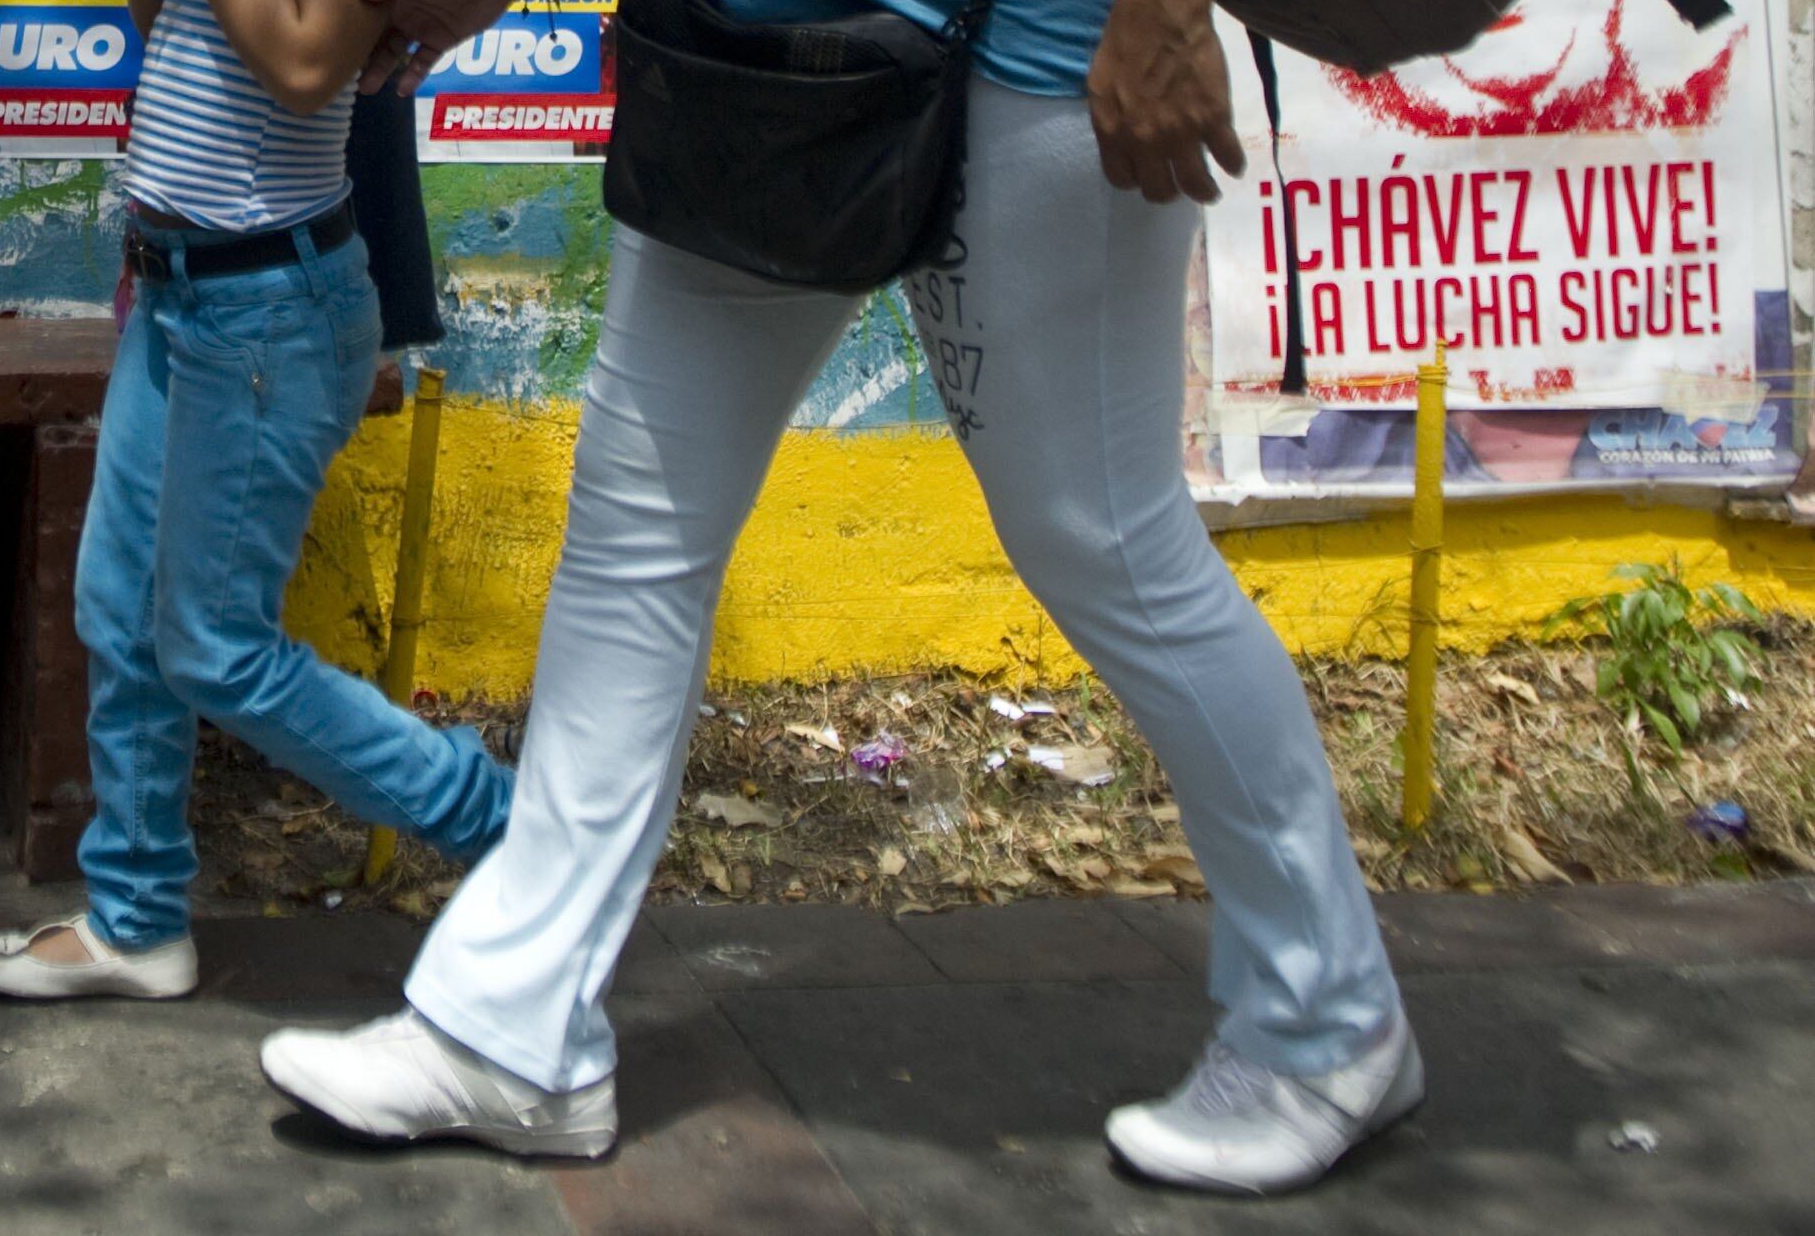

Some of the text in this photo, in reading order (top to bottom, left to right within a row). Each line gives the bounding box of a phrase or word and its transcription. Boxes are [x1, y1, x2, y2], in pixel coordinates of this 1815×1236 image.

[443, 106, 616, 130] PRESIDENTE
[1259, 155, 1719, 274] ¡CHÁVEZ VIVE!
[1266, 263, 1722, 359] ¡A LUCHA SIGUE!
[1723, 448, 1777, 464] PATRIA
